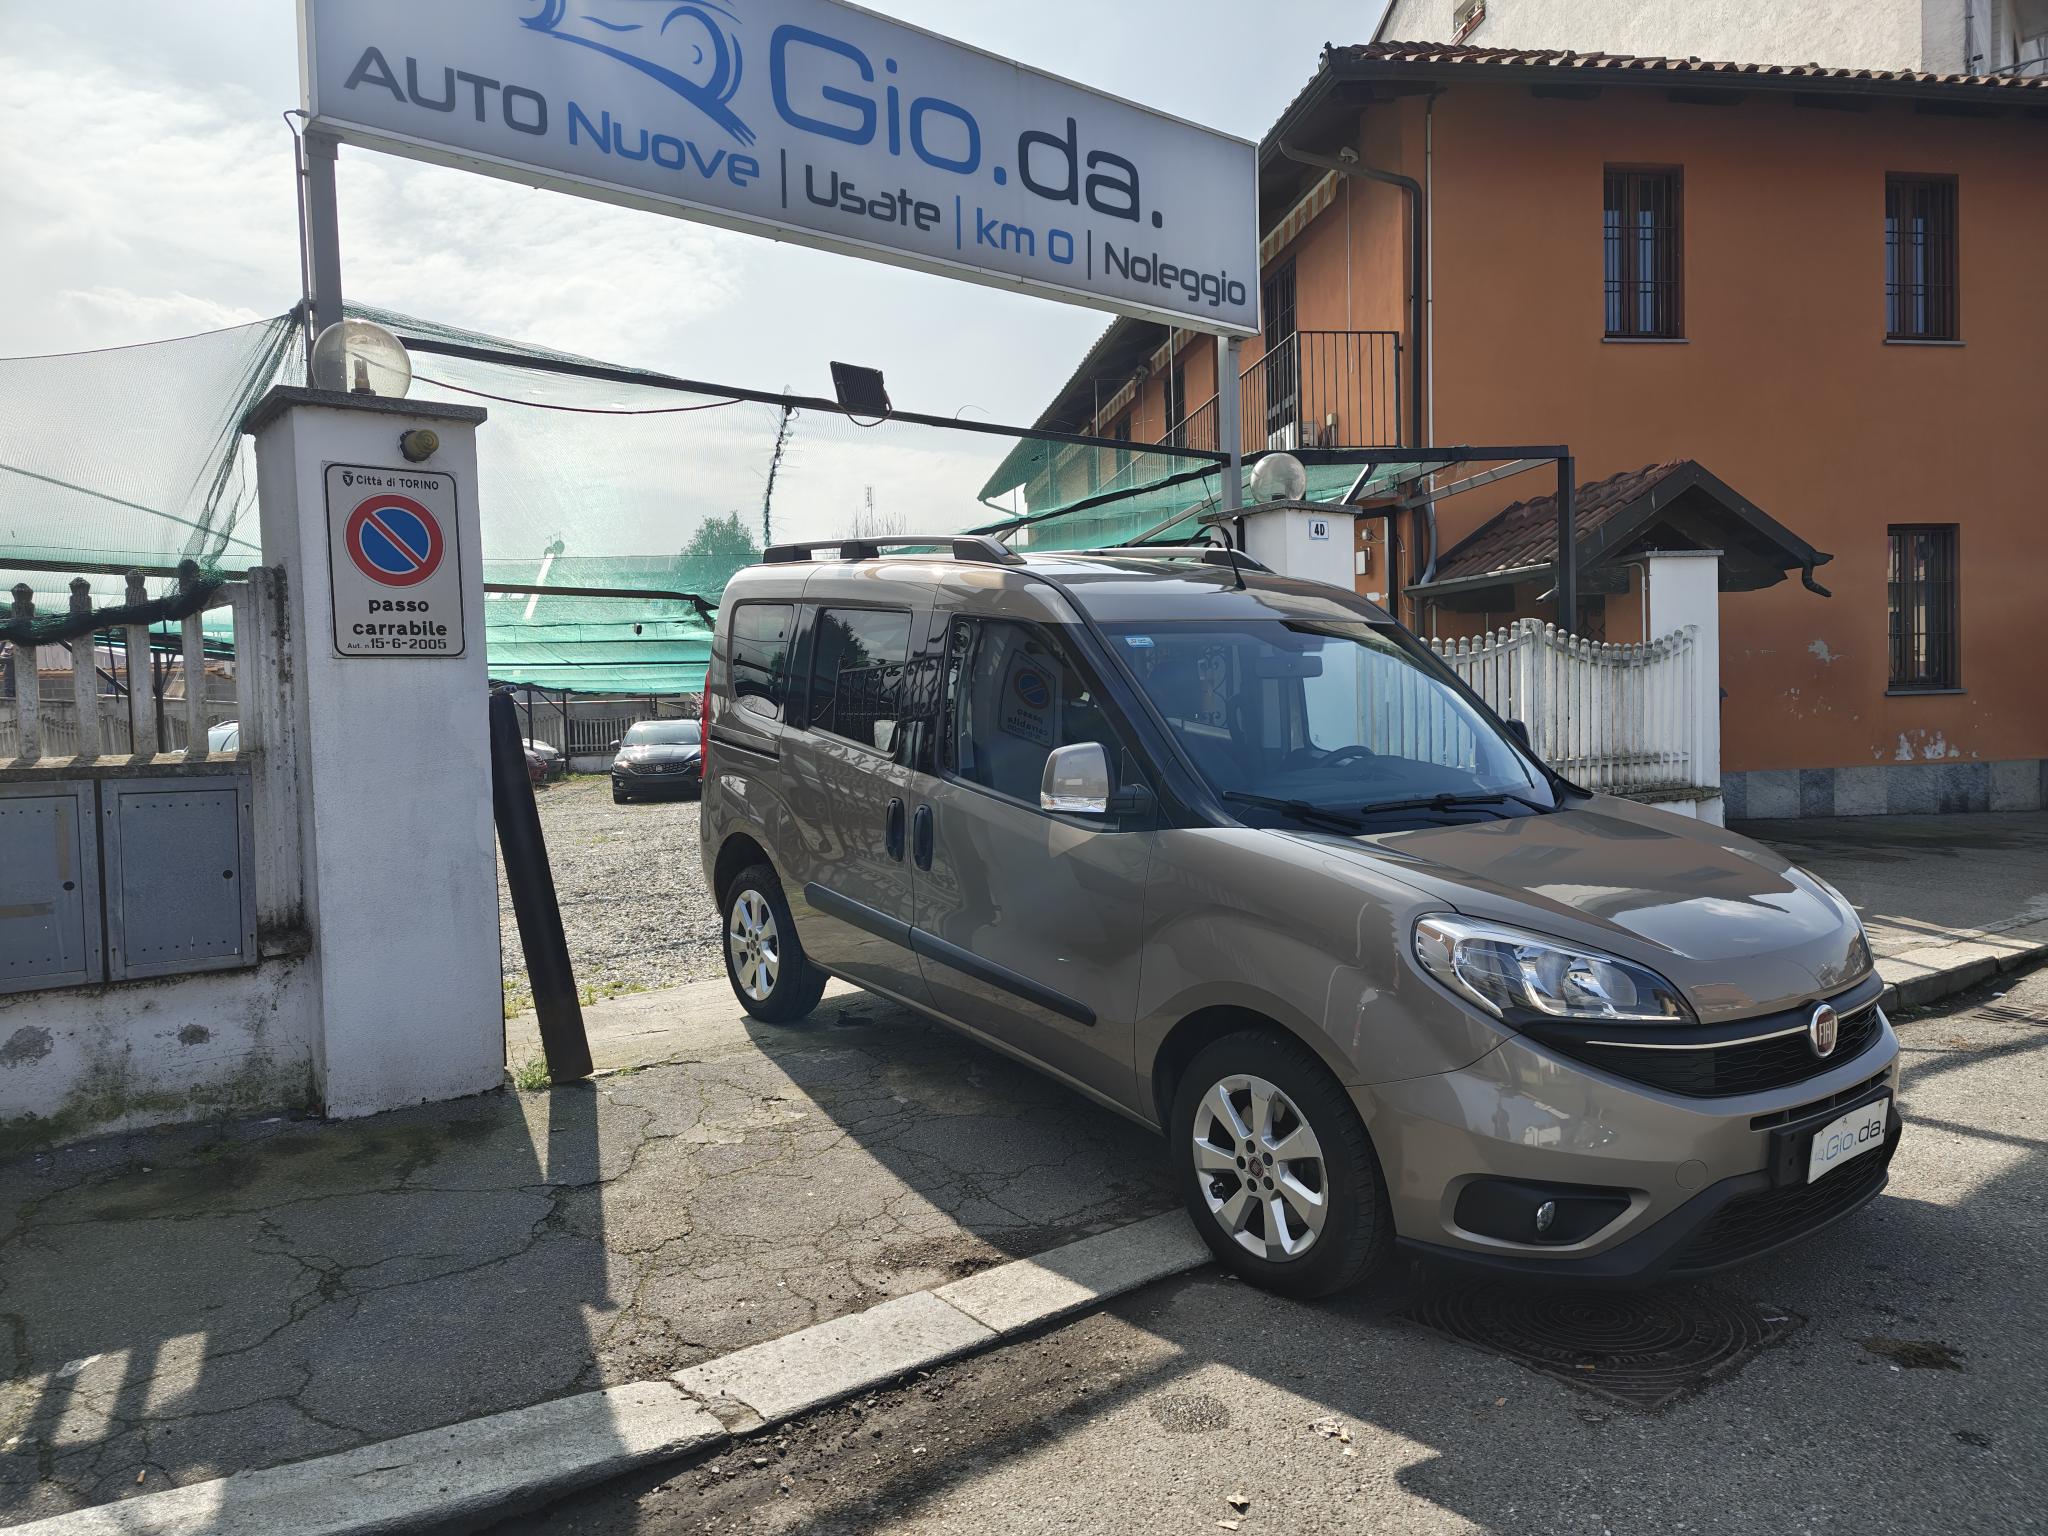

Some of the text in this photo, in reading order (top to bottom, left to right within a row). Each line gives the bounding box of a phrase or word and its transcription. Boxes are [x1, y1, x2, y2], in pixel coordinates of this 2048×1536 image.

[769, 23, 1163, 229] Gio.da.
[343, 46, 548, 136] AUTO
[567, 101, 760, 188] Nuove
[805, 164, 941, 231] Usate
[976, 207, 1034, 257] km
[1104, 241, 1246, 306] Noleggio
[386, 477, 396, 487] di
[399, 478, 439, 490] TORINO
[368, 599, 429, 614] passo
[352, 620, 447, 636] carrabile
[1818, 1019, 1834, 1046] FIAT
